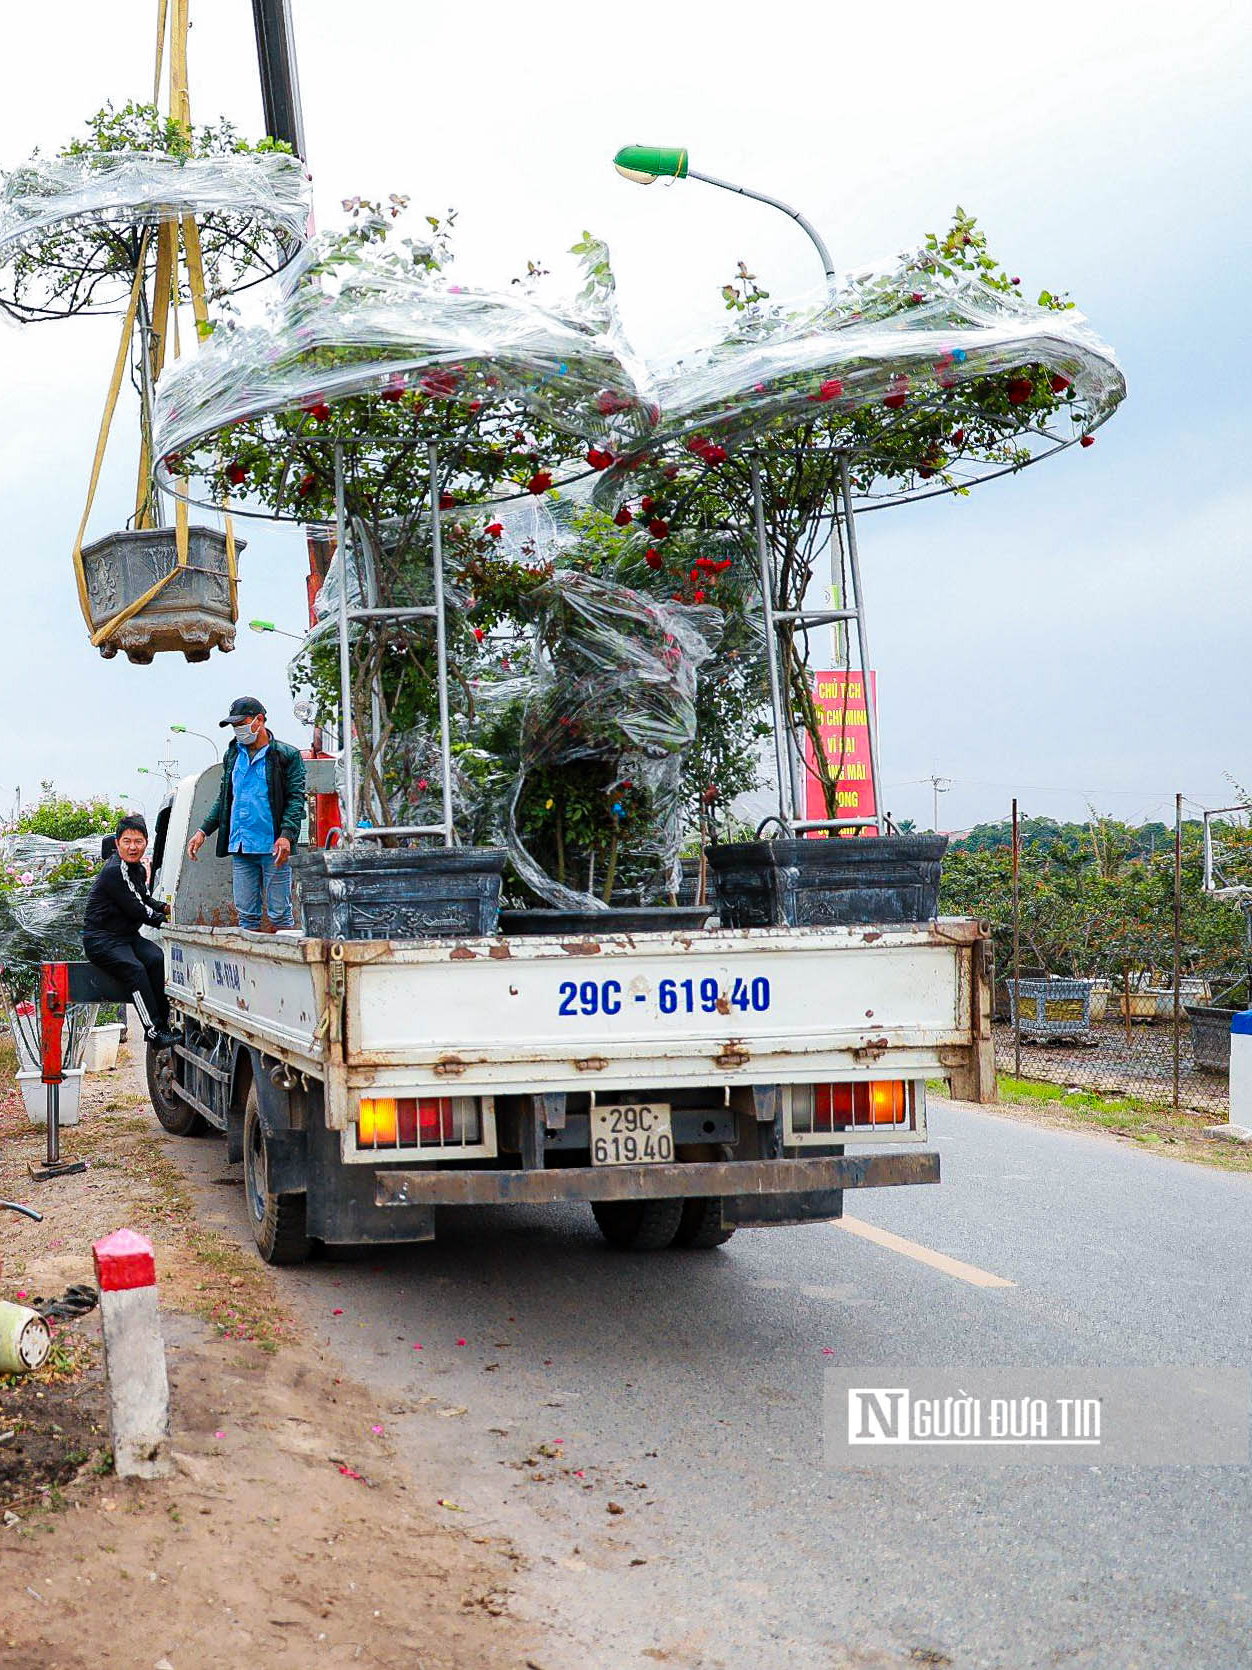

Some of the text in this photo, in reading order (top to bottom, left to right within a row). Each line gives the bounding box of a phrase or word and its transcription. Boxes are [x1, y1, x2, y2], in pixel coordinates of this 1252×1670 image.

[819, 677, 861, 699] CHỦ TCH
[558, 980, 622, 1016] 29C
[658, 976, 770, 1014] 61940
[610, 1106, 652, 1133] 29C
[595, 1134, 671, 1162] 619.40
